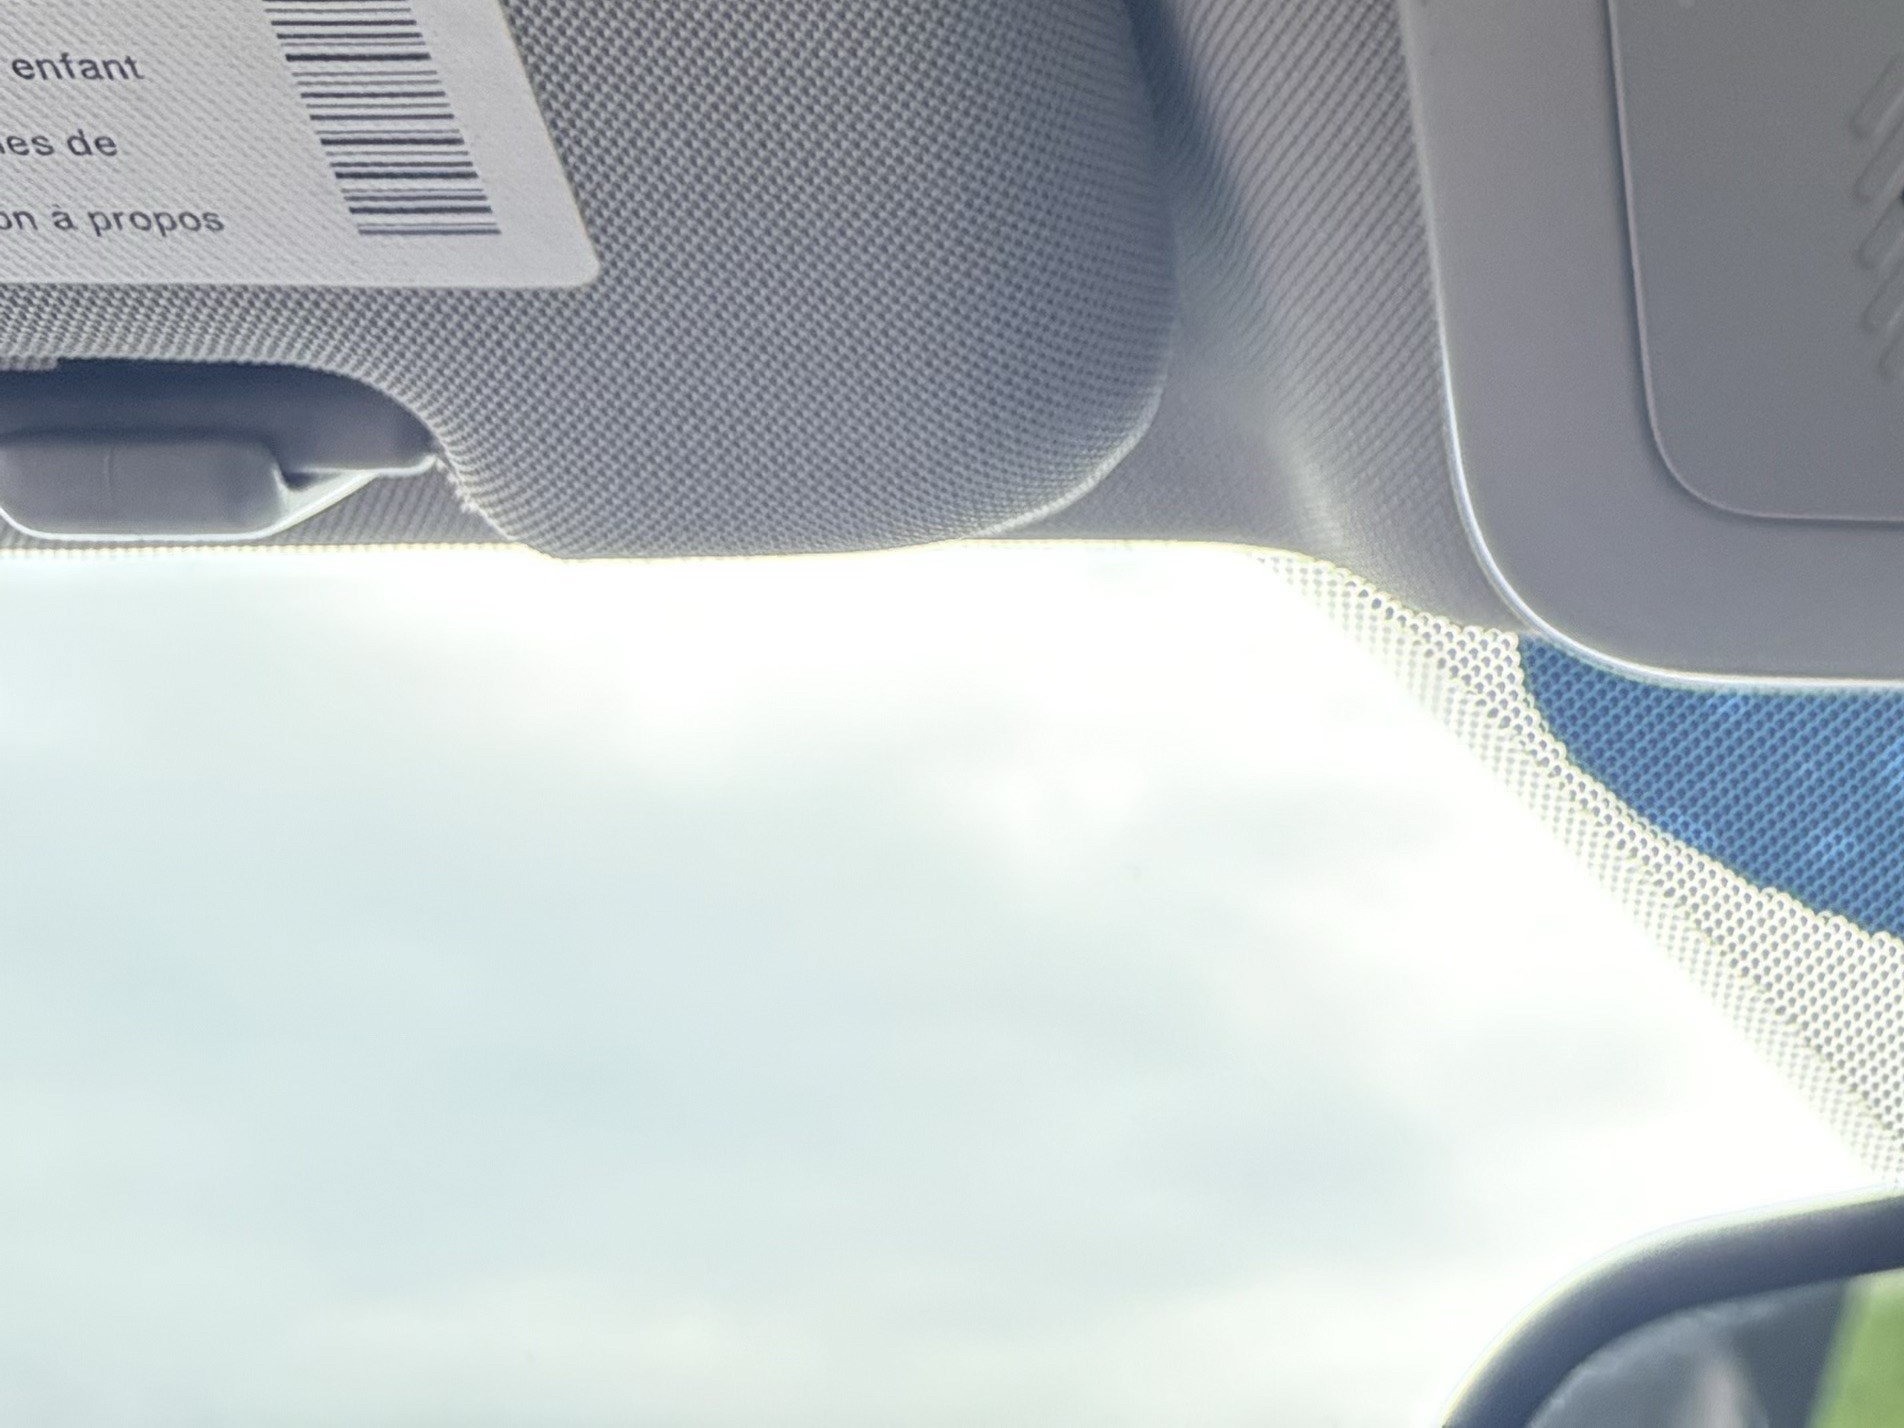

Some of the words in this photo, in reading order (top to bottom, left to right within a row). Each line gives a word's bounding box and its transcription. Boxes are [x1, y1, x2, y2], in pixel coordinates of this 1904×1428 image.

[11, 52, 145, 81] enfant
[0, 132, 55, 156] es
[66, 128, 118, 157] de
[52, 203, 76, 231] à
[87, 208, 225, 237] propos
